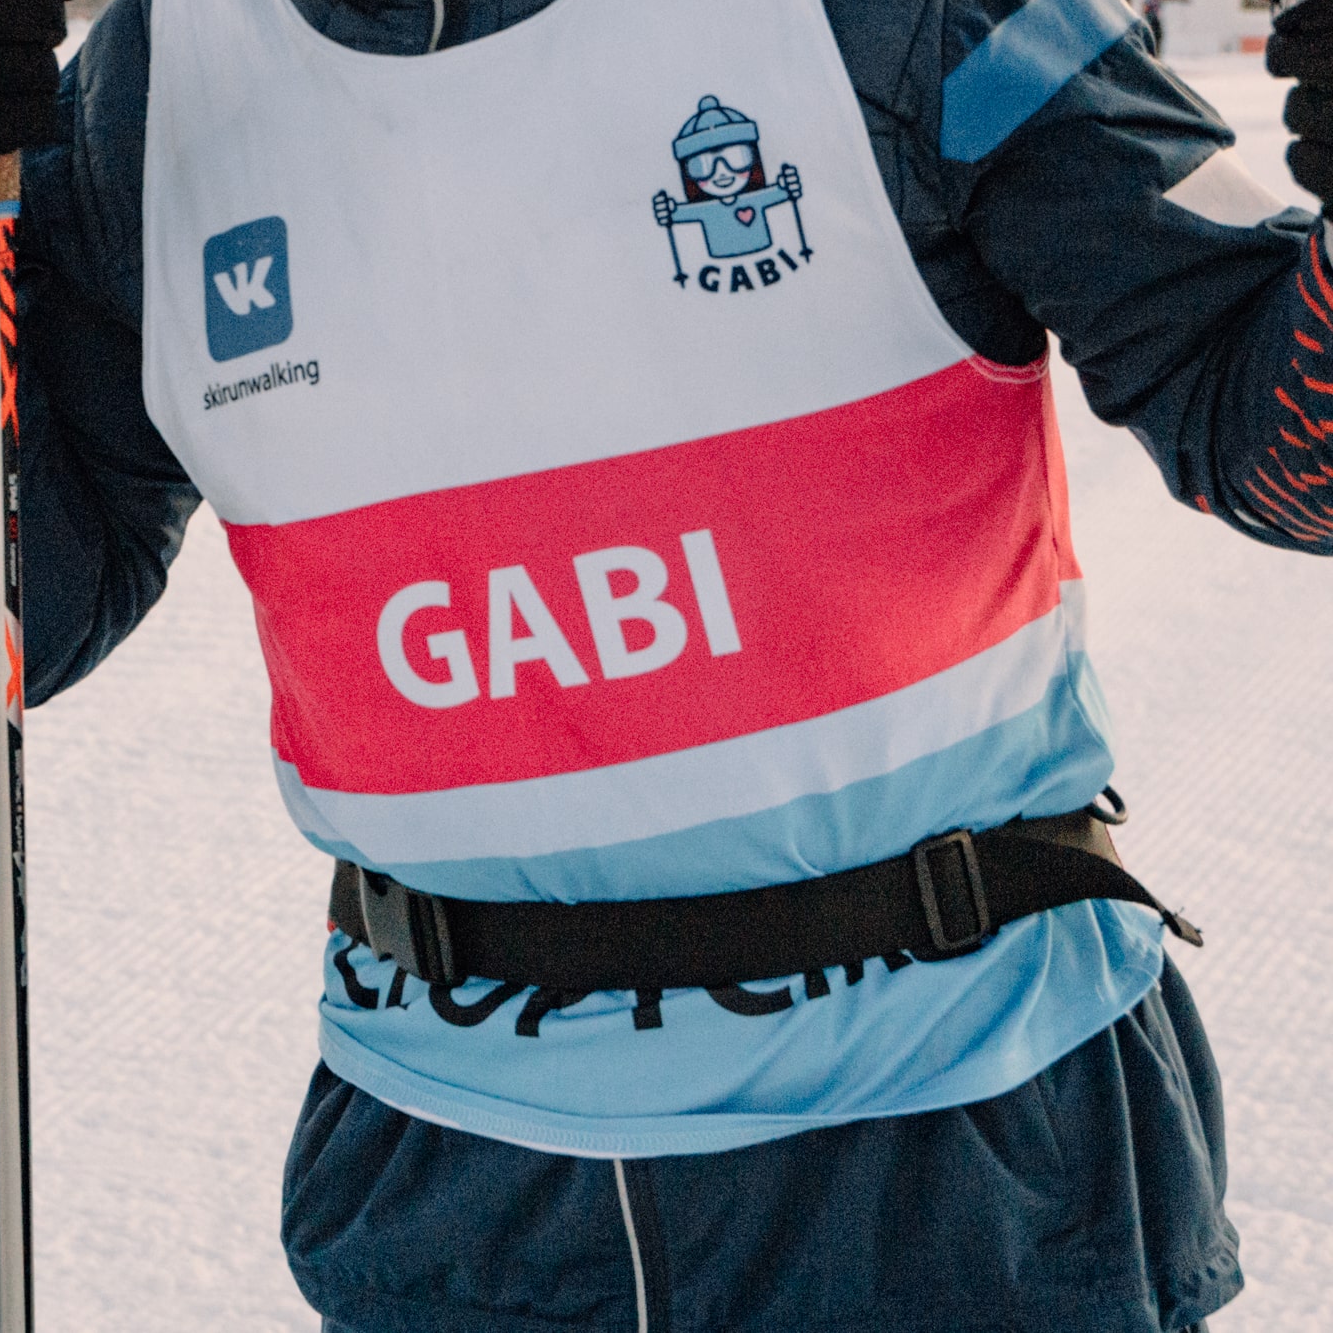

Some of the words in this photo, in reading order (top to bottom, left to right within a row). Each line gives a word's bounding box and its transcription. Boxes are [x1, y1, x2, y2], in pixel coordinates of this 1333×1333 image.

[213, 255, 277, 316] VK
[698, 247, 799, 294] GABI
[203, 359, 321, 411] skirunwalking
[376, 528, 743, 710] GABI
